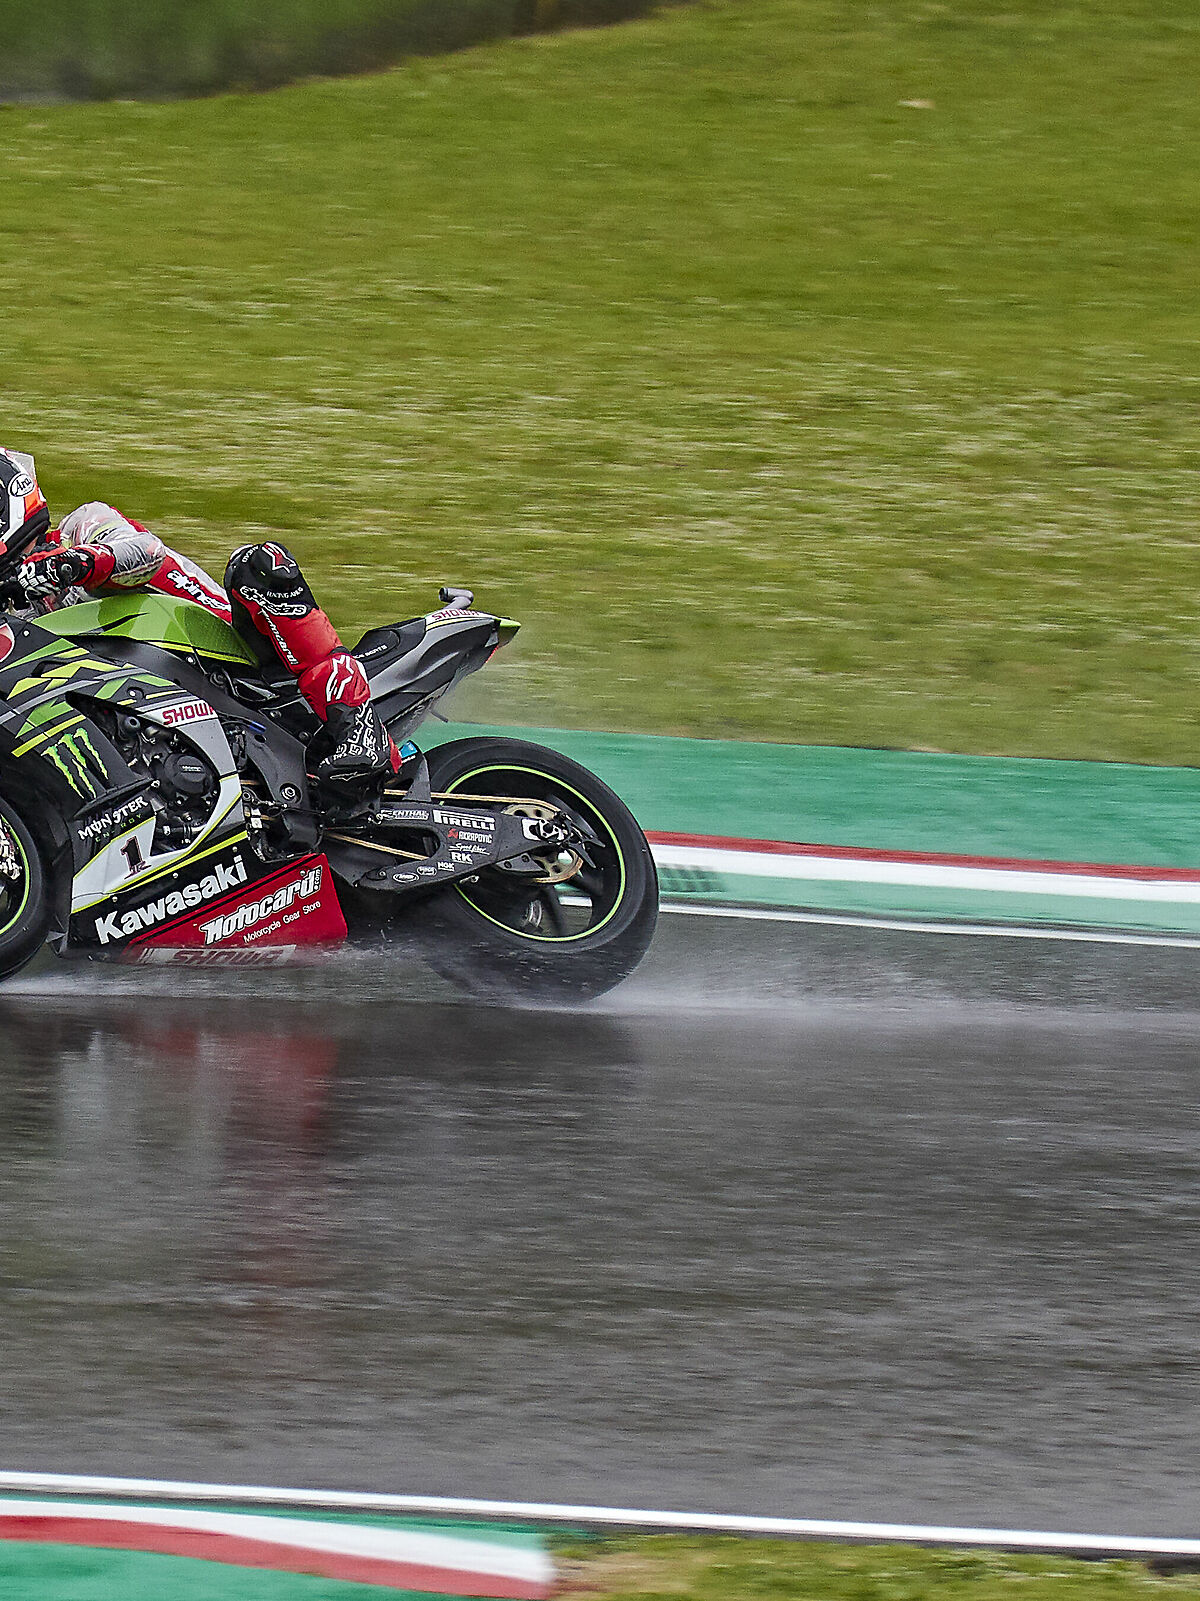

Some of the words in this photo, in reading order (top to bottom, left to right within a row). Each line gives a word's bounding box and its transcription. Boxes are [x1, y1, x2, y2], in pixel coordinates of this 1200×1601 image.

[77, 795, 149, 841] MONSTER
[432, 809, 496, 831] PIRELLI
[120, 836, 144, 873] 1
[94, 854, 248, 945] Kawasaki
[243, 920, 282, 943] Motorcycle
[282, 910, 301, 924] Gear
[302, 901, 321, 915] Store
